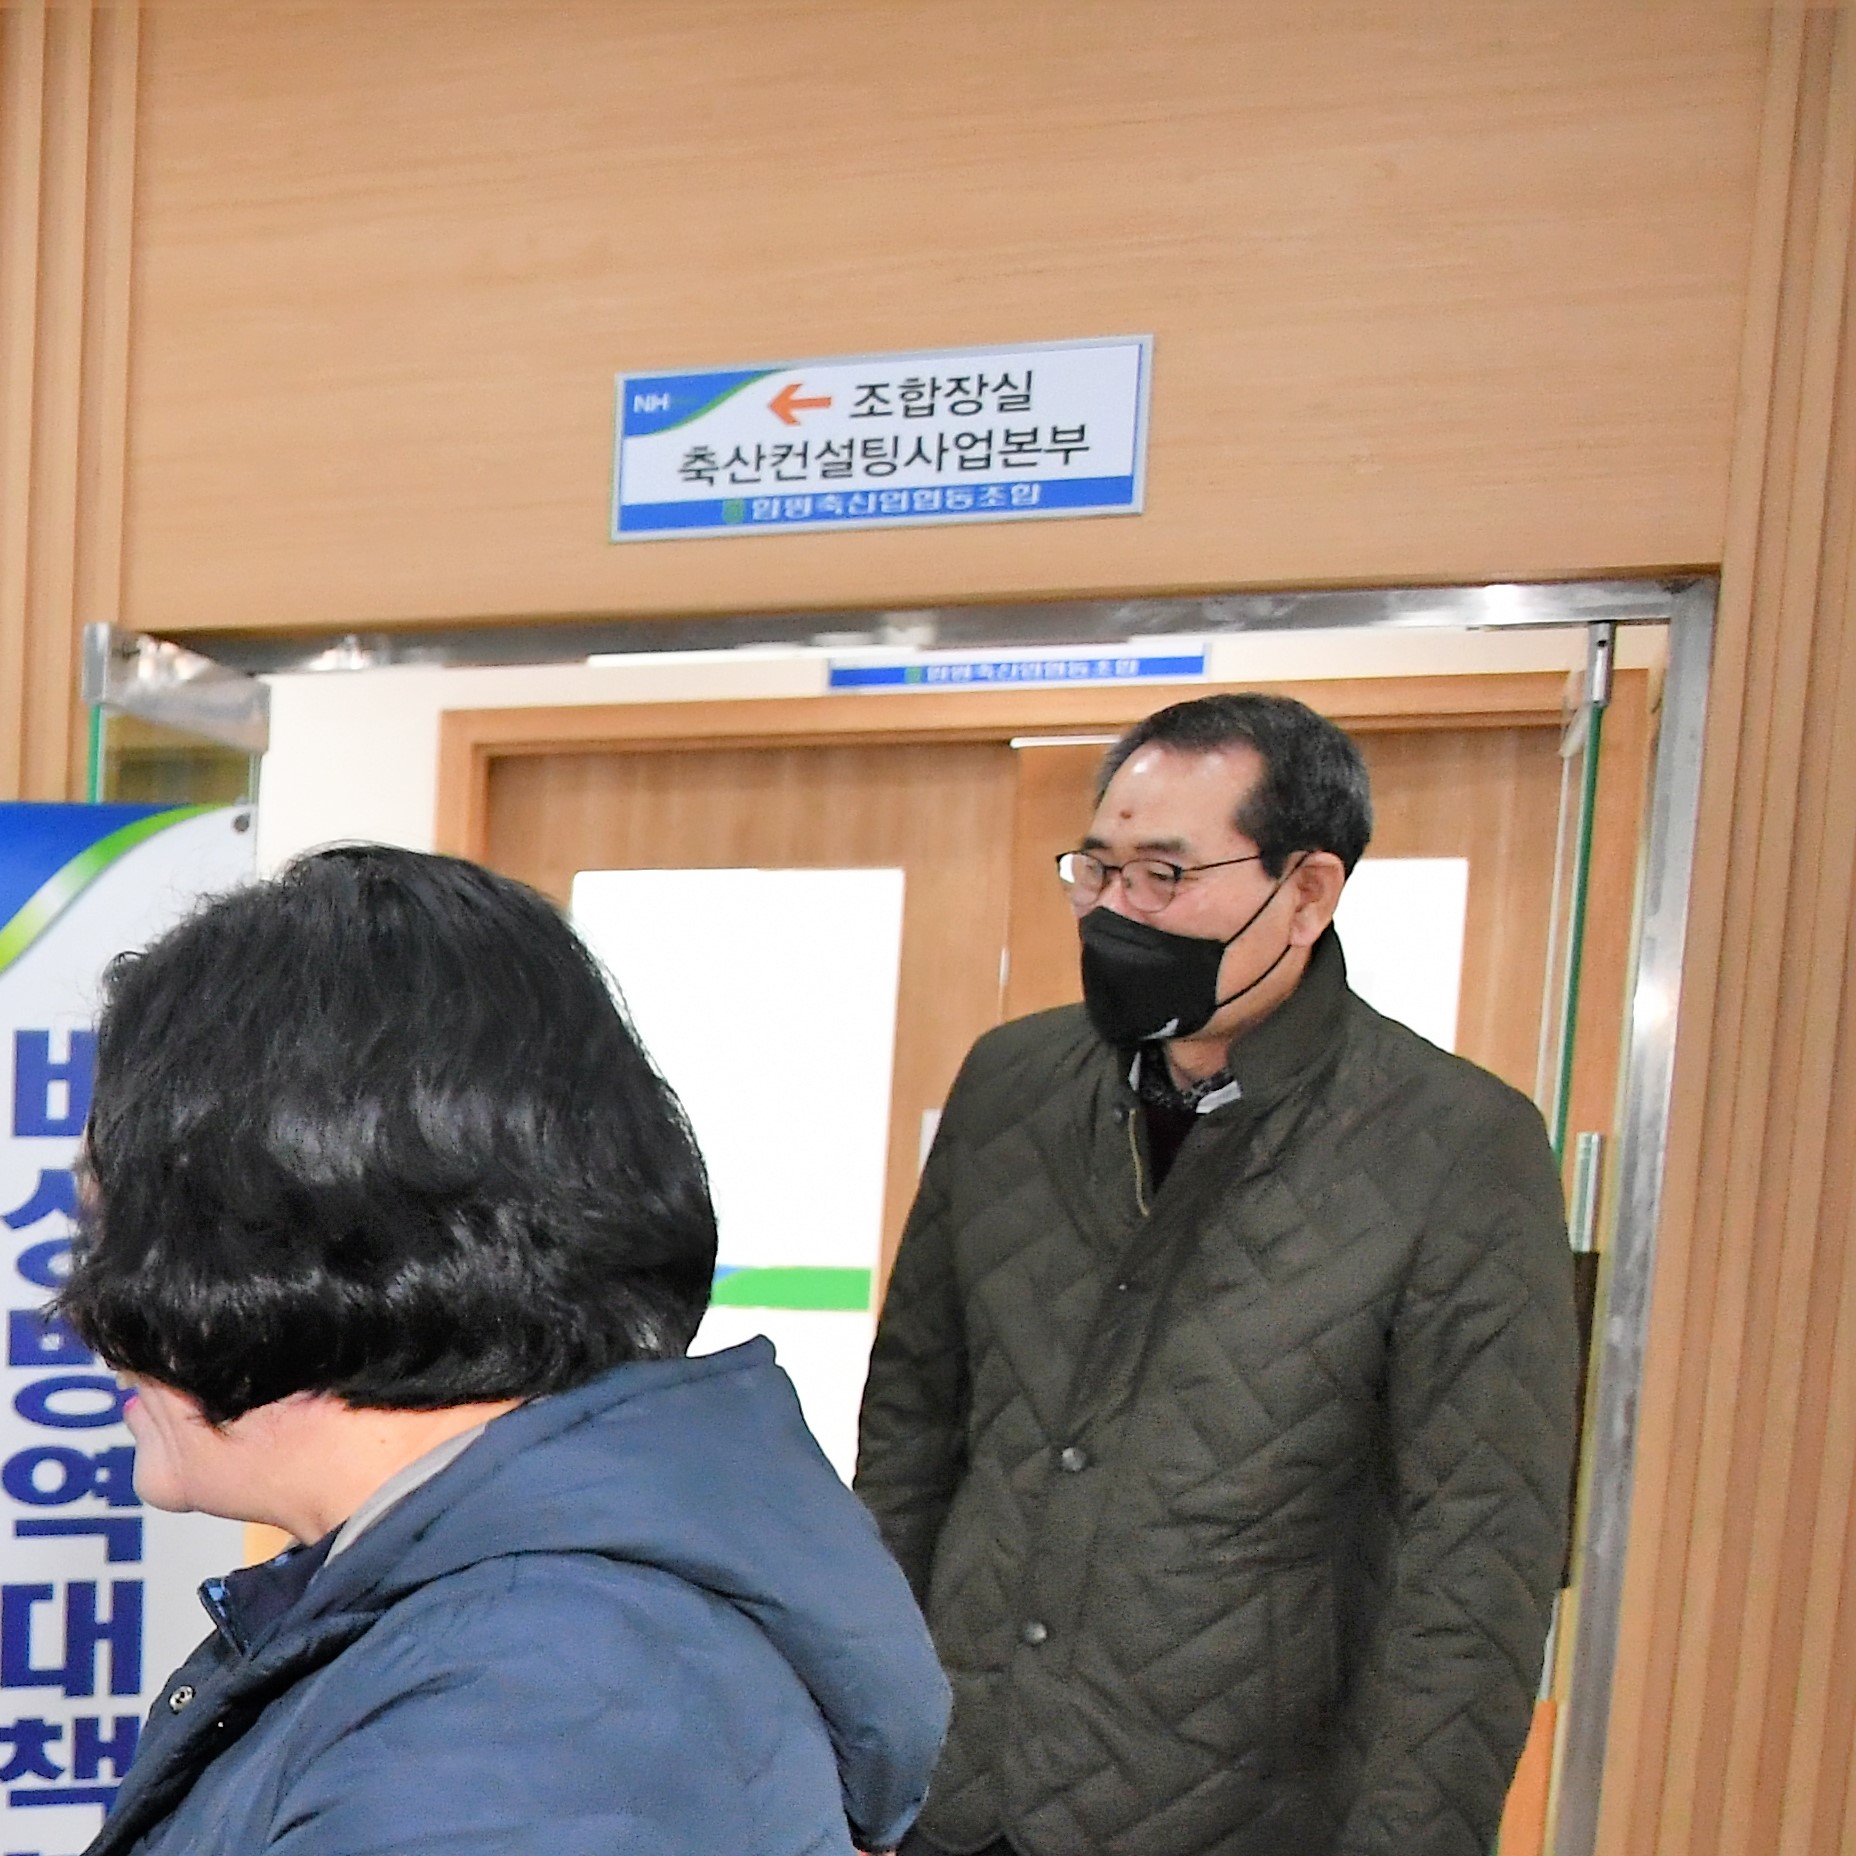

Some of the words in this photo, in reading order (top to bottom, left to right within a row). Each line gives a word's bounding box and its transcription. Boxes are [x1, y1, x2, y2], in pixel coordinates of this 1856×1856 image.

[633, 392, 670, 413] NH
[849, 369, 1034, 419] 조합장실
[678, 423, 1091, 487] 축산컨설팅사업본부
